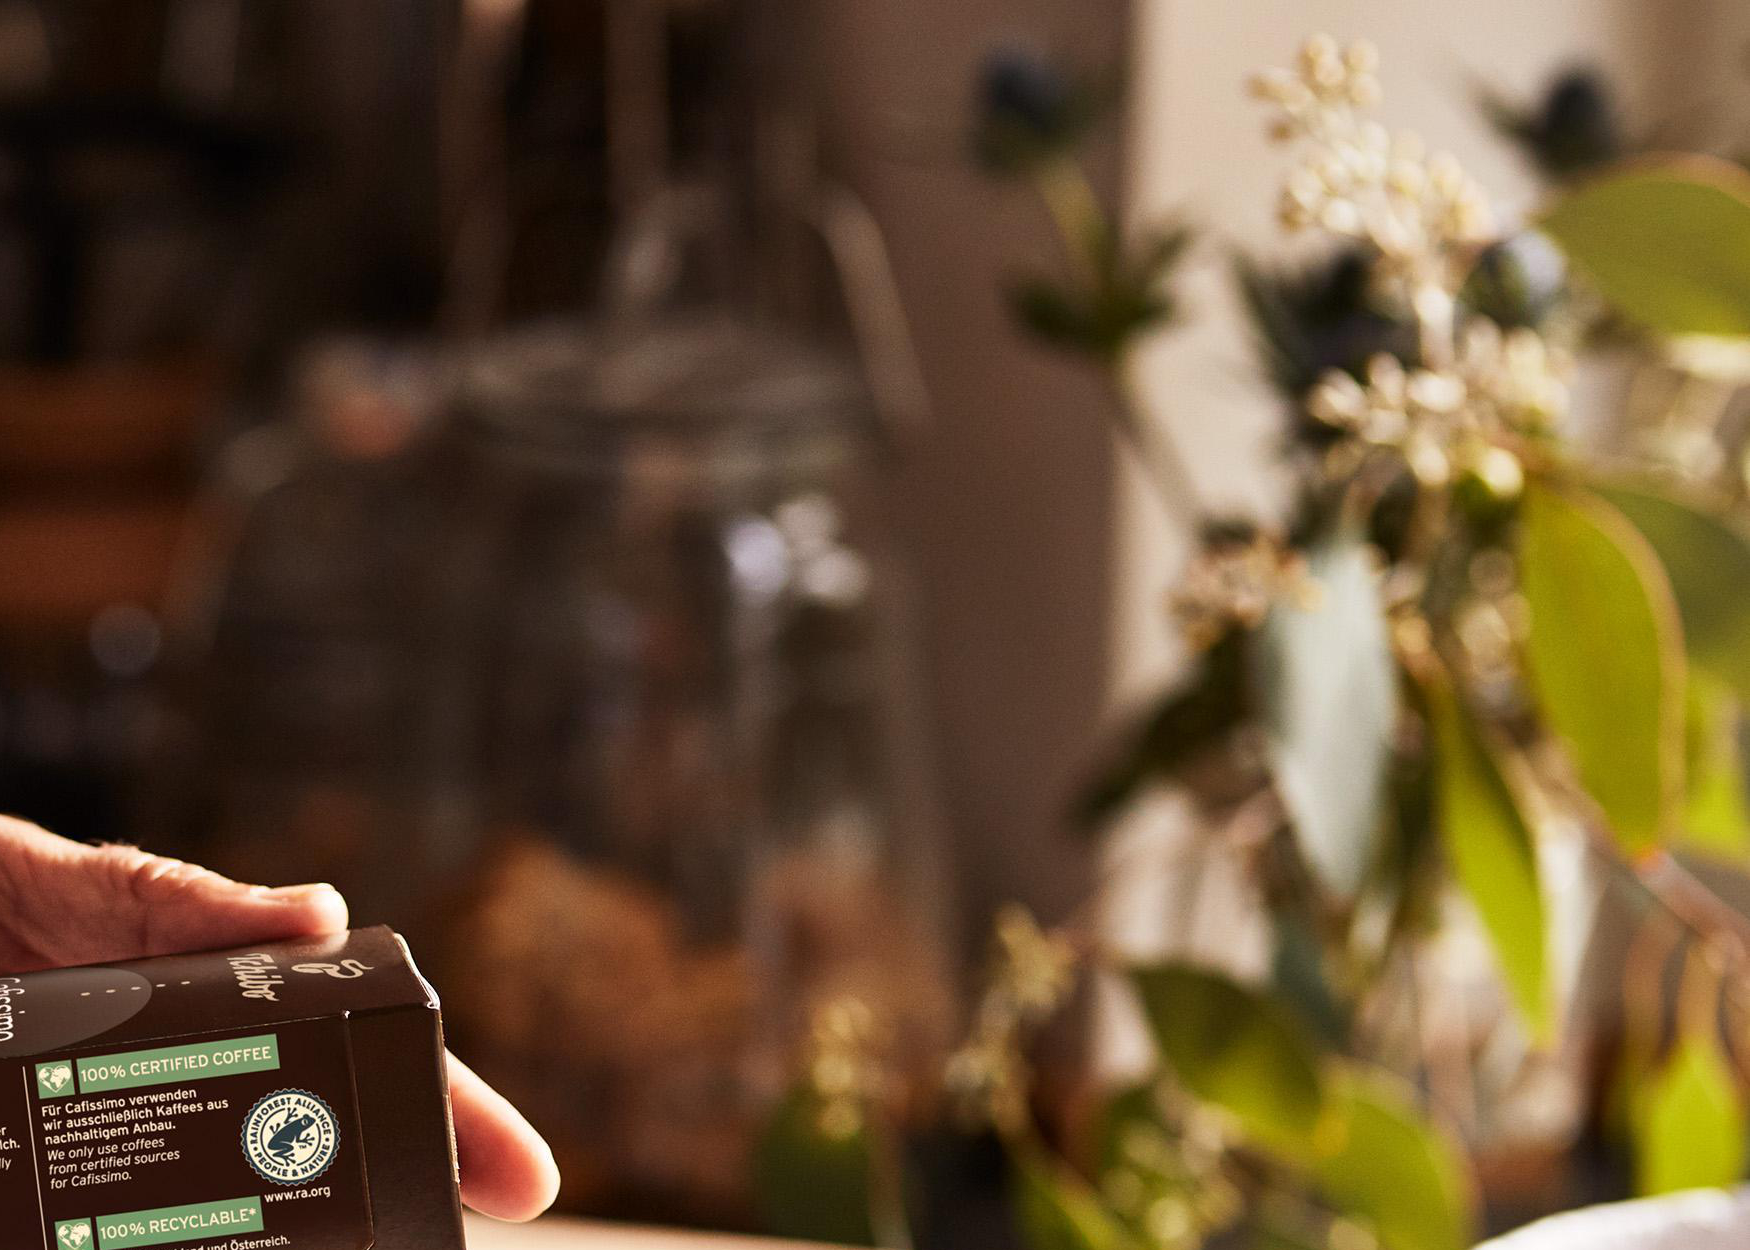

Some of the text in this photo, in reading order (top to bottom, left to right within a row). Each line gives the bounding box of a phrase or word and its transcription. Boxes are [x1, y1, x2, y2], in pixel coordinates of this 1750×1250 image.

[226, 953, 284, 1001] Tchibo
[81, 1046, 271, 1082] 100% CERTIFIED COFFEE
[41, 1089, 196, 1116] Für Cafissimo verwenden
[43, 1099, 228, 1130] wir ausschließlich Kaffees aus
[45, 1121, 175, 1145] nachhaltigem Anbau.
[250, 1097, 332, 1145] RAINFOREST ALLIANCE
[47, 1138, 164, 1161] We only use coffees
[255, 1144, 330, 1177] PEOPLE & NATURE
[49, 1150, 180, 1175] from certified sources
[50, 1171, 131, 1189] for Cafissimo.
[264, 1186, 330, 1202] www.ra.org
[100, 1222, 145, 1239] 100%
[230, 1235, 290, 1250] Österreich.
